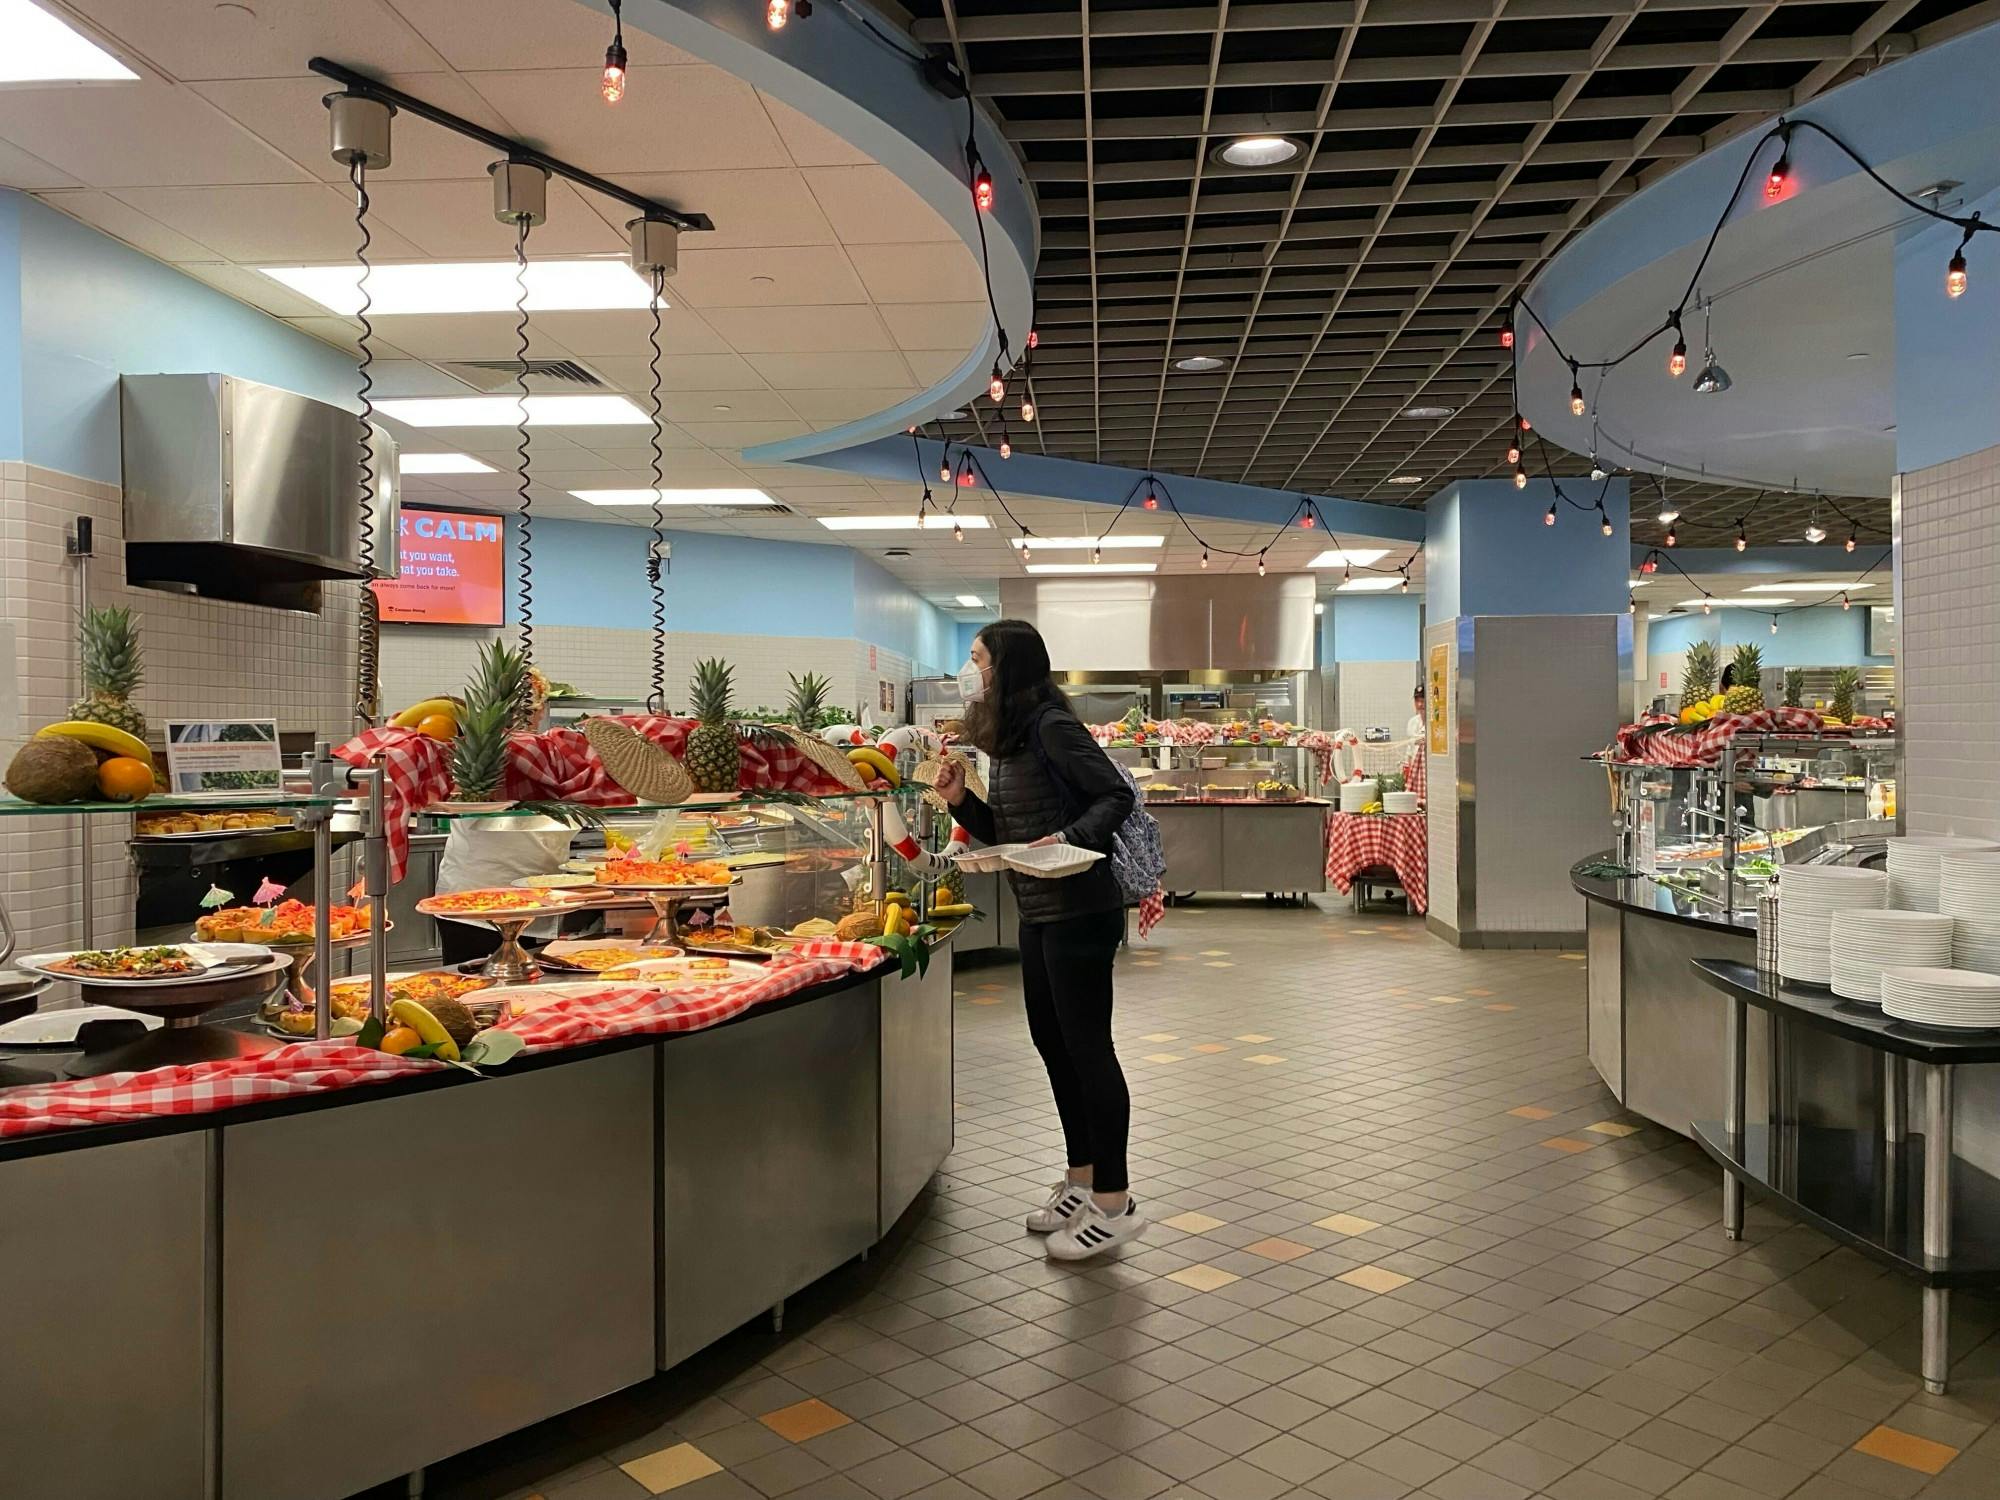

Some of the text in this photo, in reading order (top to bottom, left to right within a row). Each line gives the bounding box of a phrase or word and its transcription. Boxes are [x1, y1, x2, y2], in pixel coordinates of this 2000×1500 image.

[415, 517, 497, 542] CALM
[409, 551, 426, 562] you
[429, 552, 455, 564] want,
[416, 566, 433, 577] you
[436, 566, 460, 577] take.
